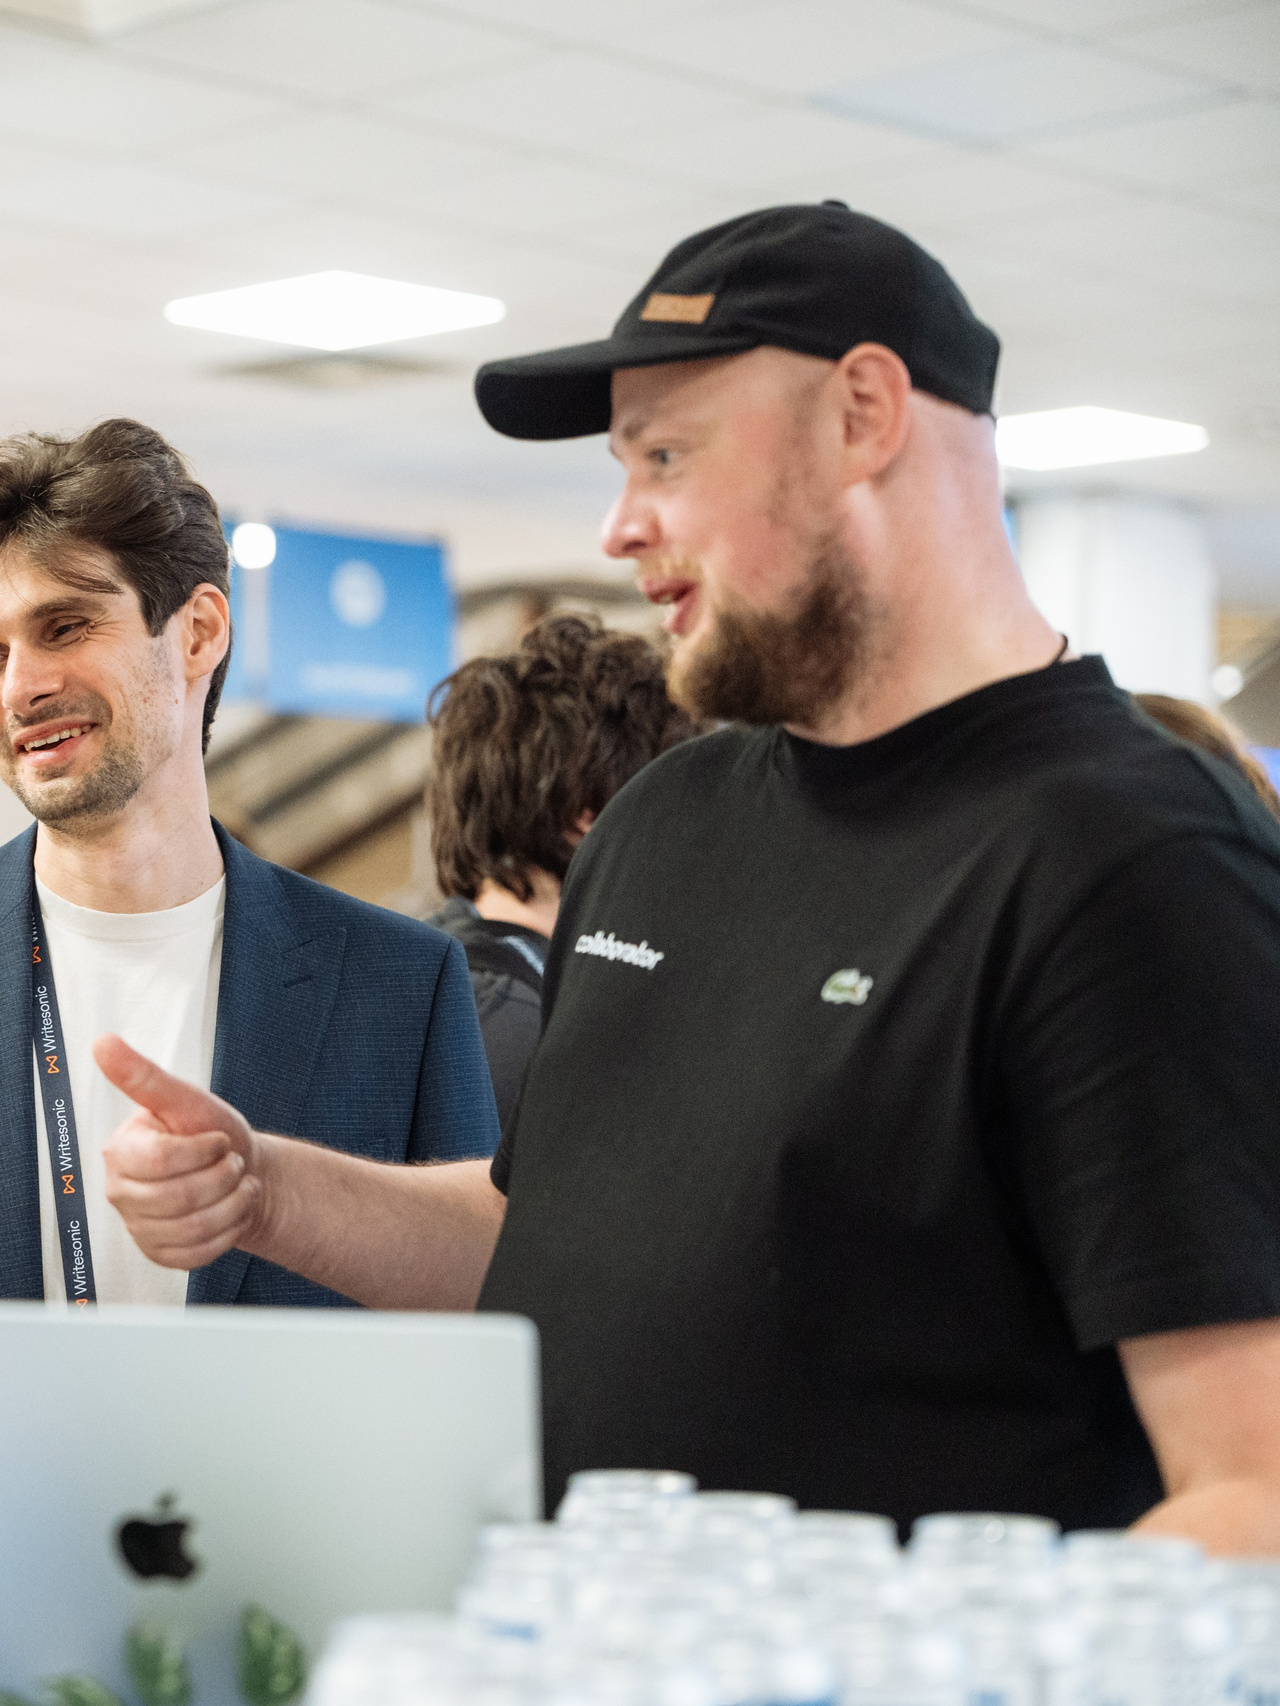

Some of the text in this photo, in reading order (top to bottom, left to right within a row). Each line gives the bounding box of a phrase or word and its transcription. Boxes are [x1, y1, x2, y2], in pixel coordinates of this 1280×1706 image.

[35, 985, 57, 1053] Writesonic
[52, 1098, 73, 1172] Writesonic
[67, 1219, 88, 1296] Writesonic
